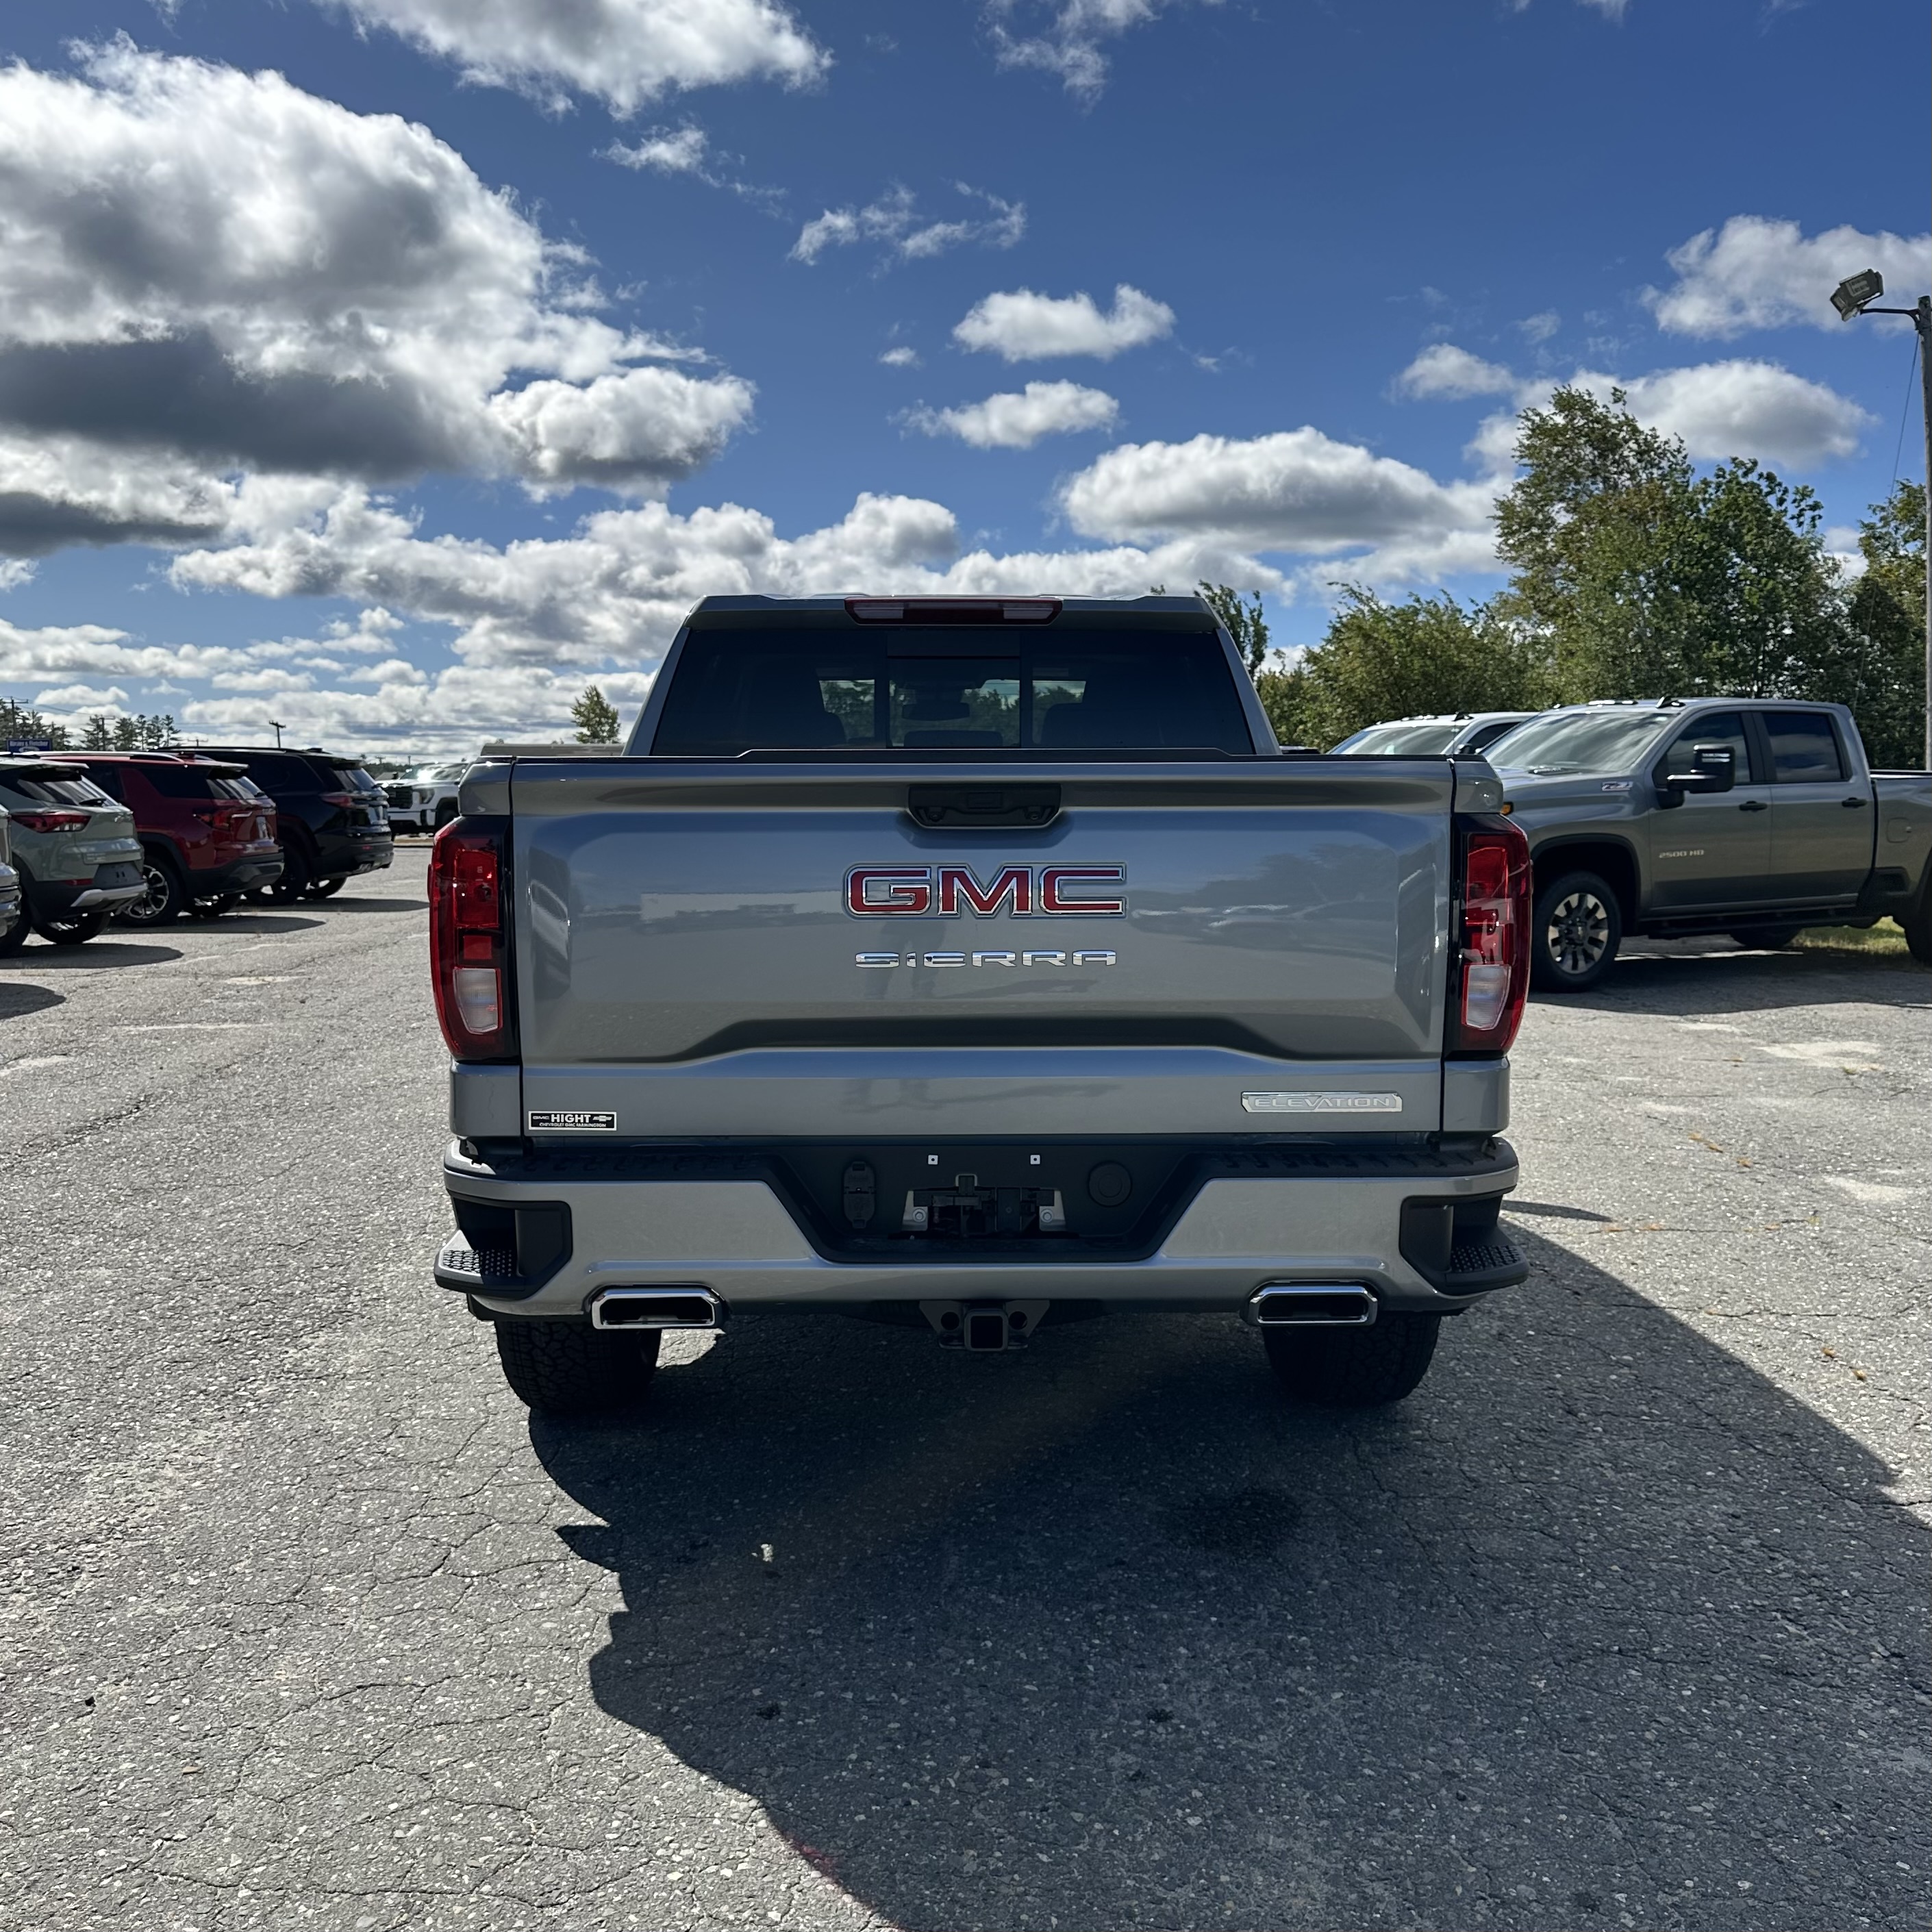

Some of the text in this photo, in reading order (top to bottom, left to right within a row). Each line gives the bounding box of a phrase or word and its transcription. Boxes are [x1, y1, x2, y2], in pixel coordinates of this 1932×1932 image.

[846, 864, 1126, 917] GMC
[855, 950, 1117, 968] SIERRA
[1255, 1097, 1390, 1107] ELEVATION
[551, 1114, 591, 1122] HIGHT
